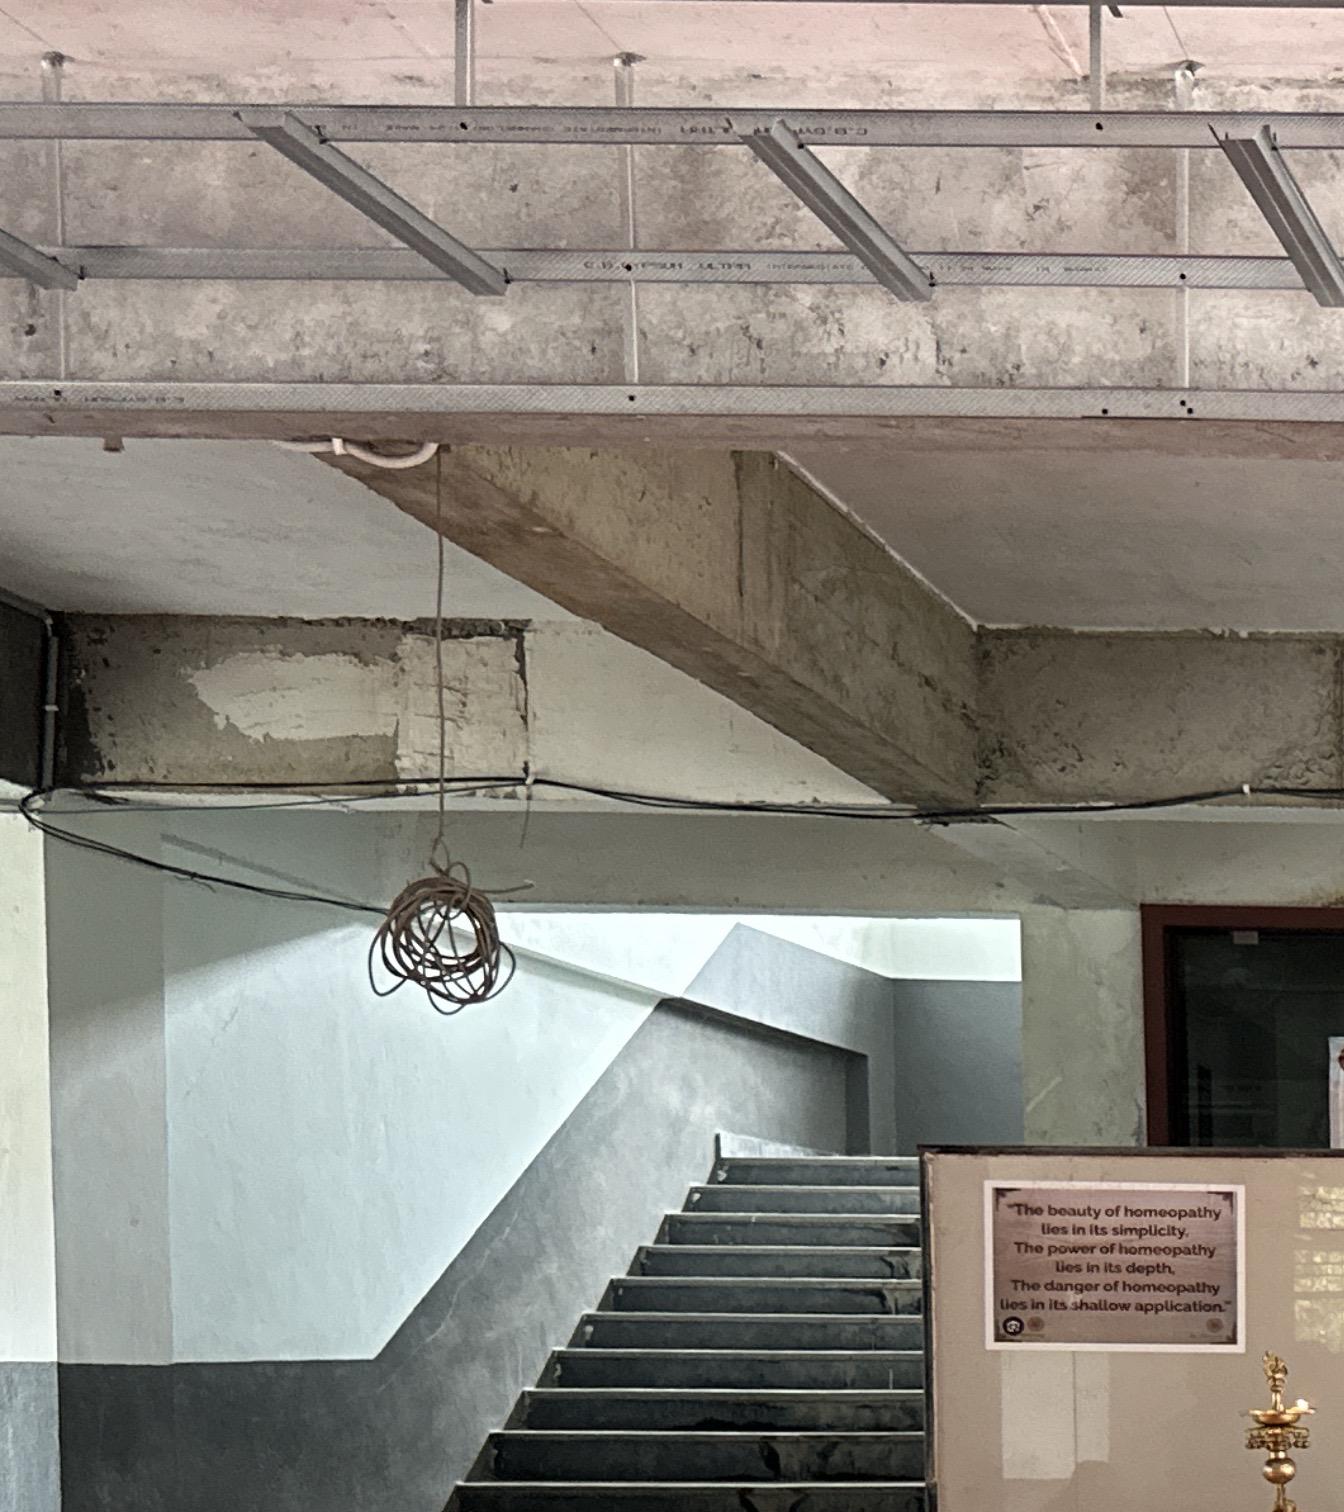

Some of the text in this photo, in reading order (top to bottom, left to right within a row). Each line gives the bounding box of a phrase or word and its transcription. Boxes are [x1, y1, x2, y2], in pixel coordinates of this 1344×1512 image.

[1048, 1204, 1100, 1220] beauty
[1105, 1205, 1121, 1218] of
[1124, 1205, 1222, 1220] homeopathy
[1041, 1223, 1068, 1235] lies
[1073, 1223, 1086, 1236] in
[1090, 1223, 1108, 1236] its
[1014, 1241, 1216, 1258] The power of homeopathy
[1055, 1260, 1175, 1276] lies in its depth,
[1010, 1279, 1220, 1296] The danger of homeopathy
[1000, 1299, 1027, 1311] lies
[1031, 1299, 1045, 1311] in
[1049, 1299, 1067, 1311] its
[1070, 1299, 1131, 1311] shallow
